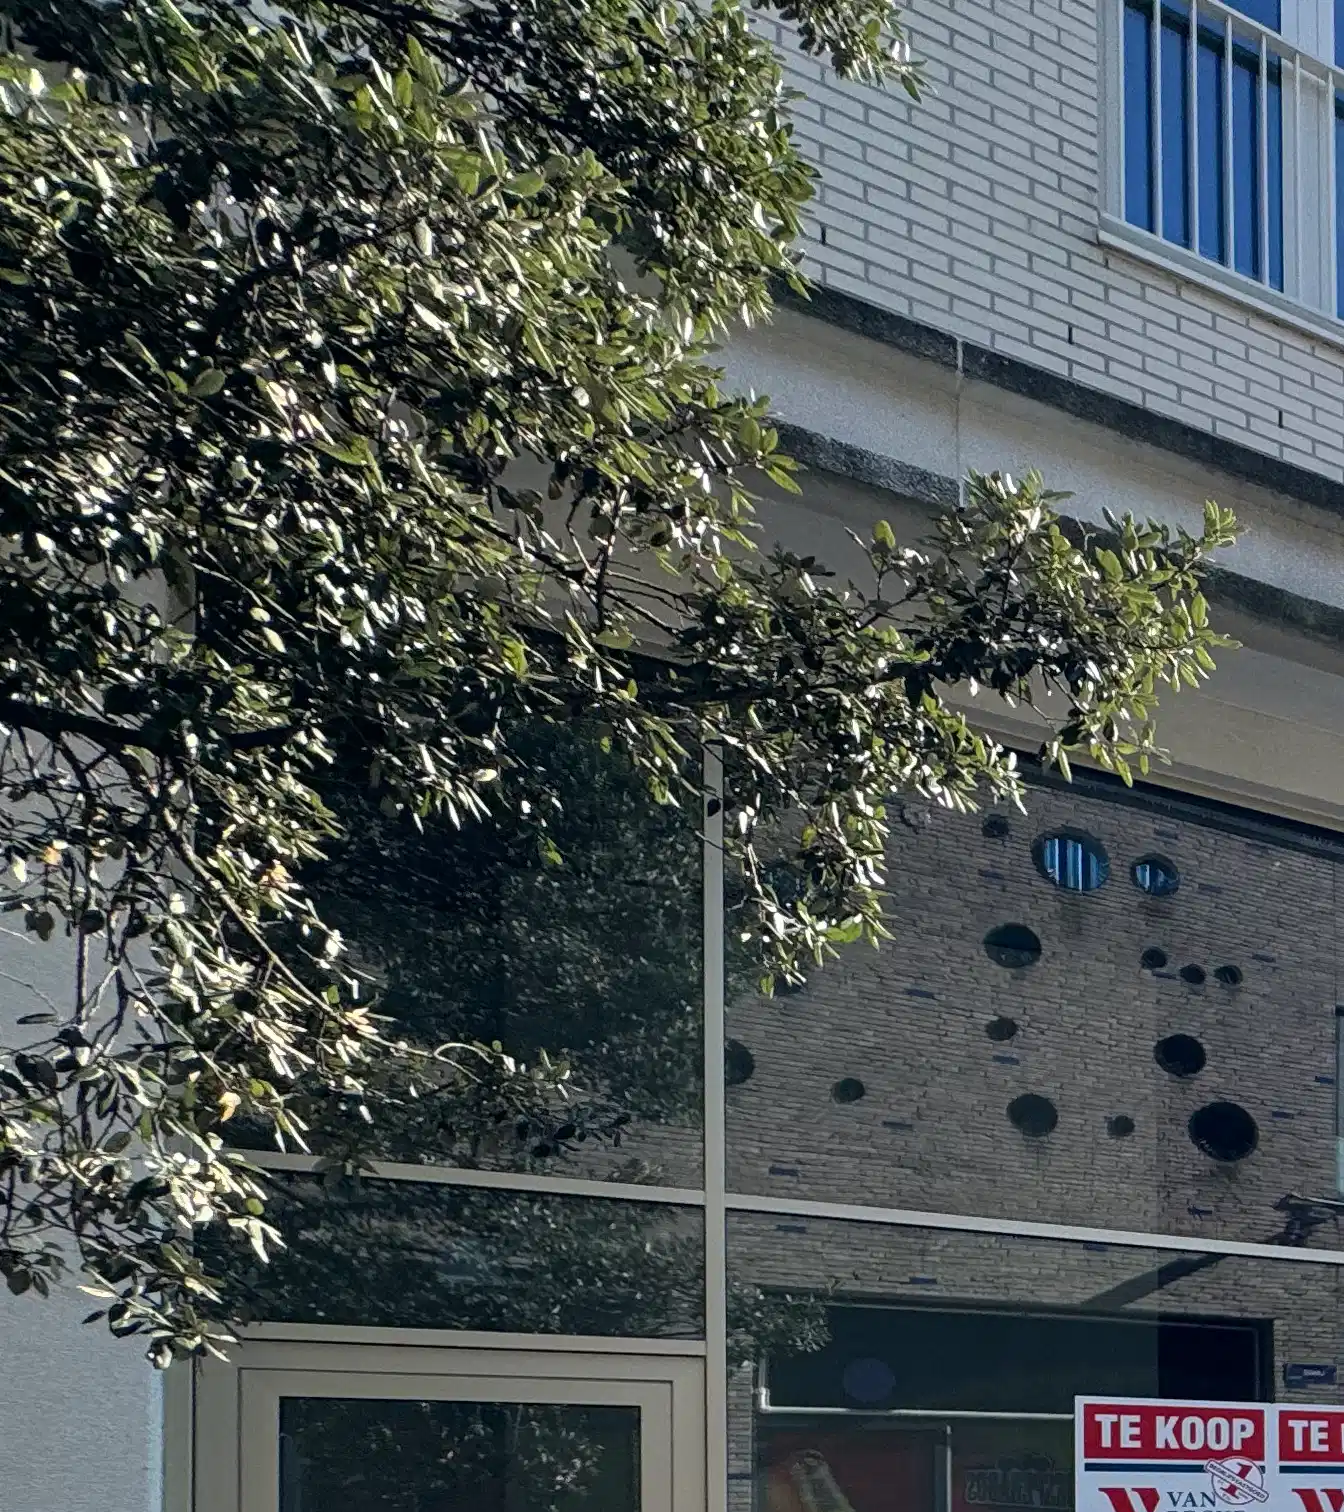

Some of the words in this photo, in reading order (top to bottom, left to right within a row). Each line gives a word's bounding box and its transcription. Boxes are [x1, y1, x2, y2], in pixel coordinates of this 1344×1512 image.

[1095, 1413, 1142, 1449] TE
[1156, 1415, 1255, 1451] KOOP
[1288, 1420, 1330, 1453] TE
[1167, 1491, 1217, 1508] VAN
